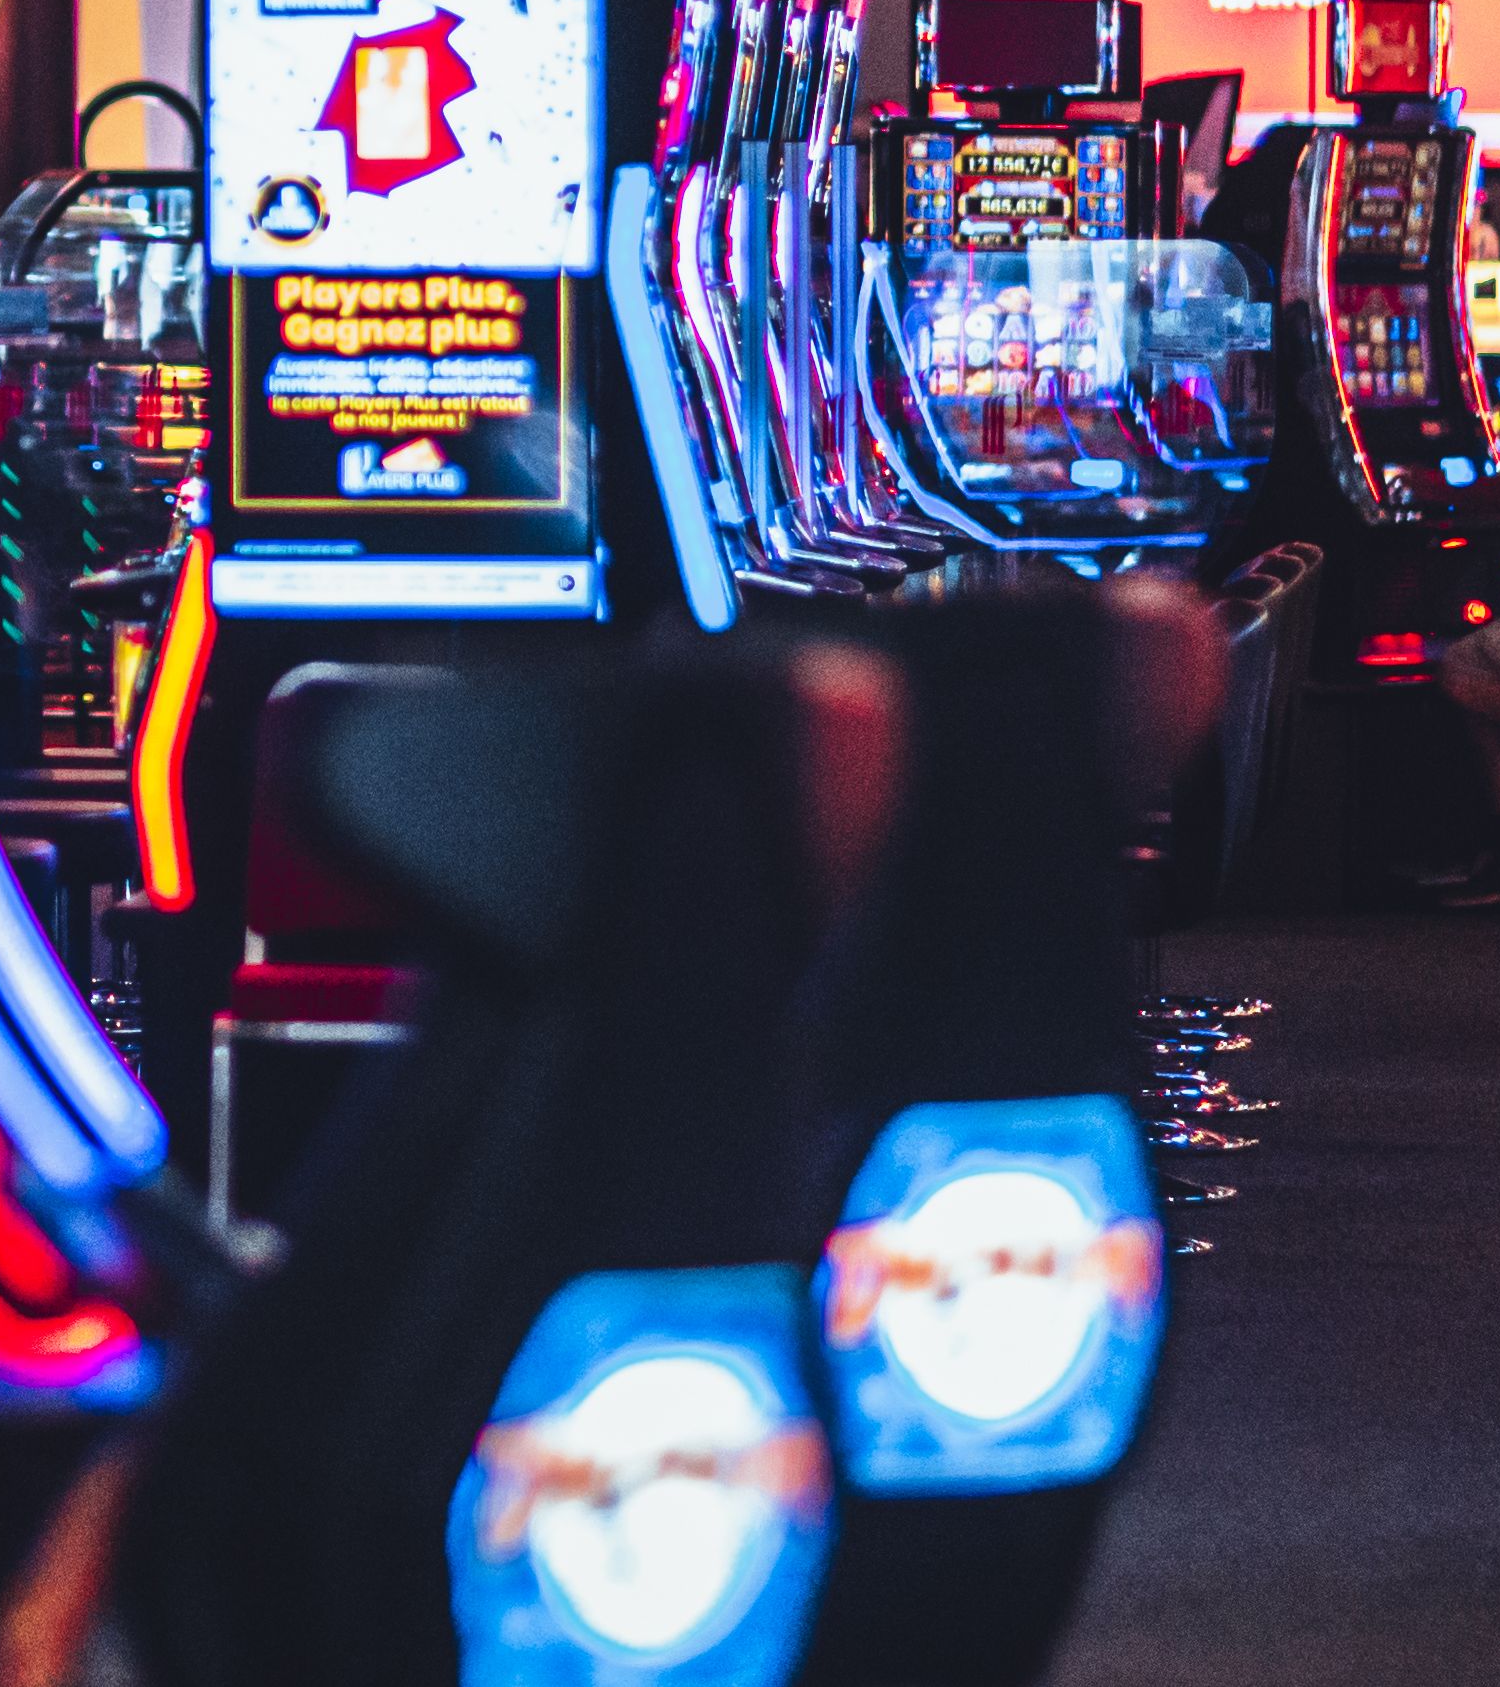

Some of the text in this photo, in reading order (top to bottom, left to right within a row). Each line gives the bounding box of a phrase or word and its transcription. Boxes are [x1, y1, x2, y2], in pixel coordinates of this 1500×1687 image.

[276, 275, 526, 316] Players Plus,
[284, 312, 515, 355] Gagnez plus
[291, 397, 337, 411] carte
[339, 395, 401, 414] Players
[404, 395, 439, 411] Plus
[441, 397, 469, 411] est
[332, 412, 356, 428] de
[358, 415, 390, 428] nos
[392, 413, 456, 432] joueurs
[415, 471, 456, 489] PLUS
